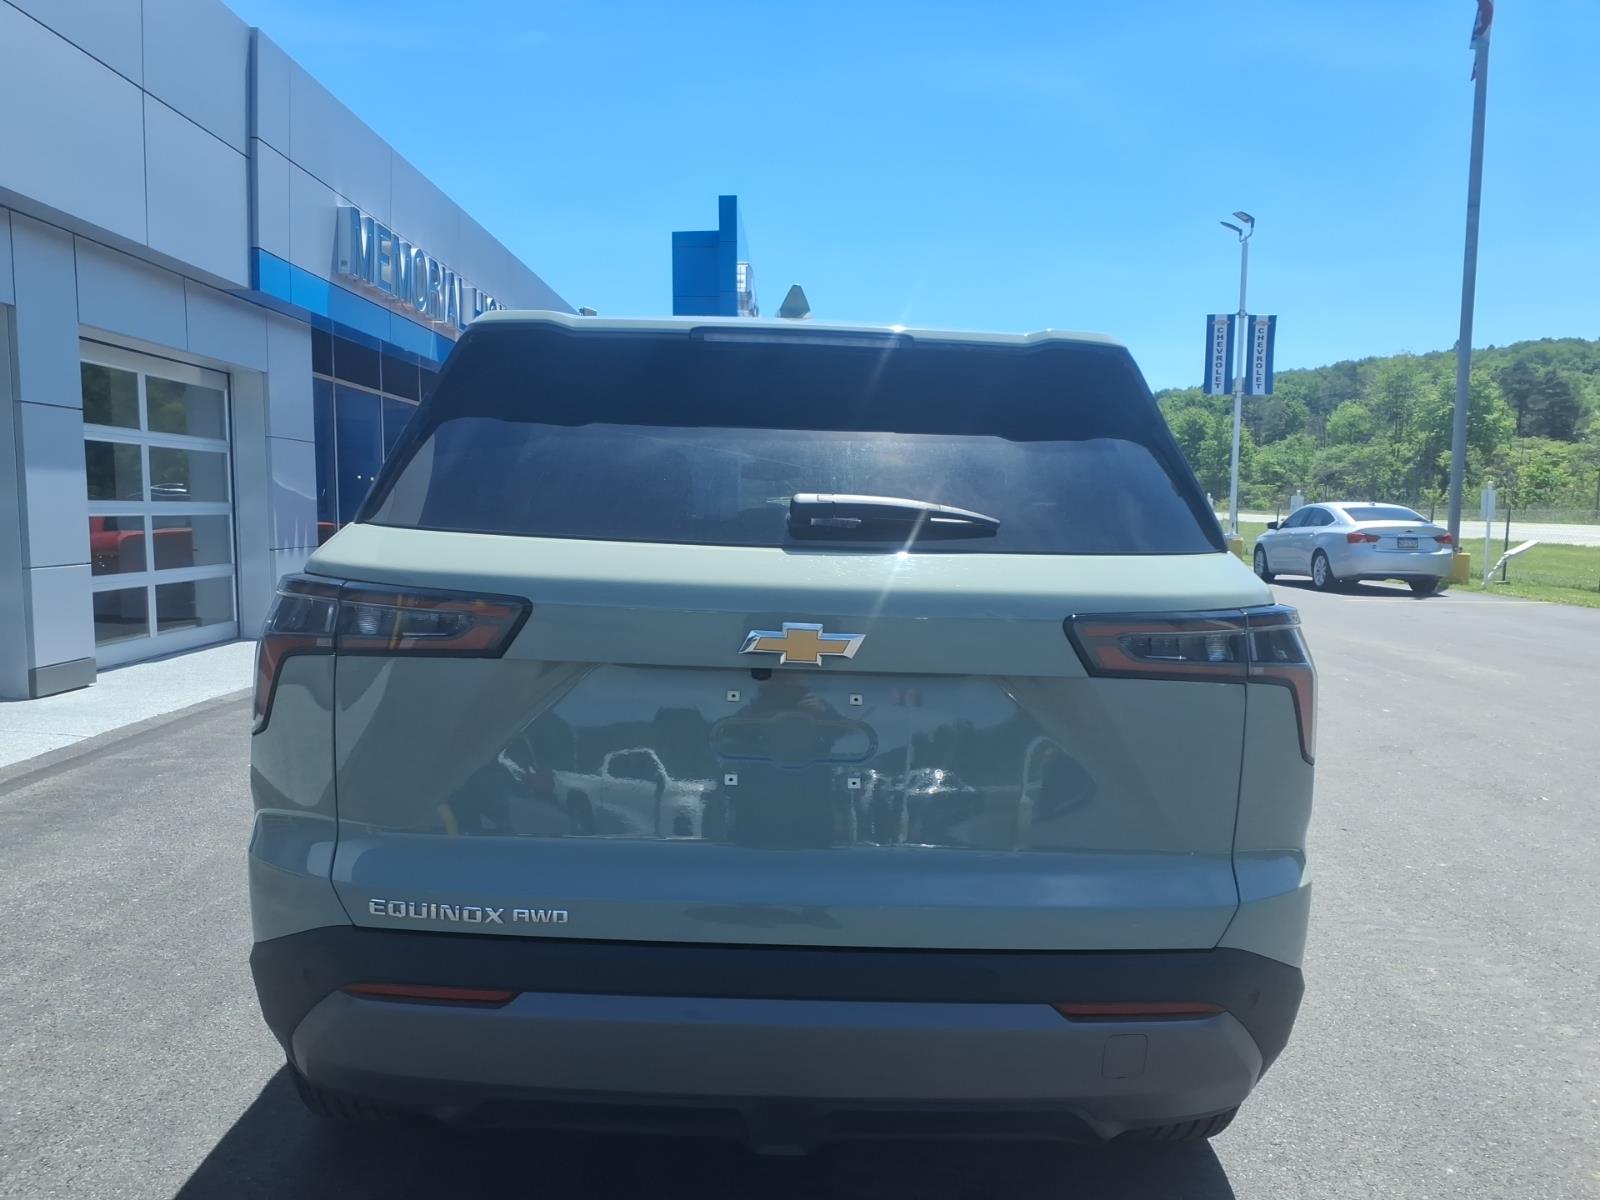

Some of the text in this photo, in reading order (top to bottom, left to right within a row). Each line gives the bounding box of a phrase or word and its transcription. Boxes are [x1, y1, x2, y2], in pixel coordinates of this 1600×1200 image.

[337, 205, 467, 331] MEMORIAL
[1215, 327, 1224, 388] CHEVROLET
[1256, 328, 1264, 389] CHEVROLET
[368, 898, 569, 925] EQUINOX AWD
